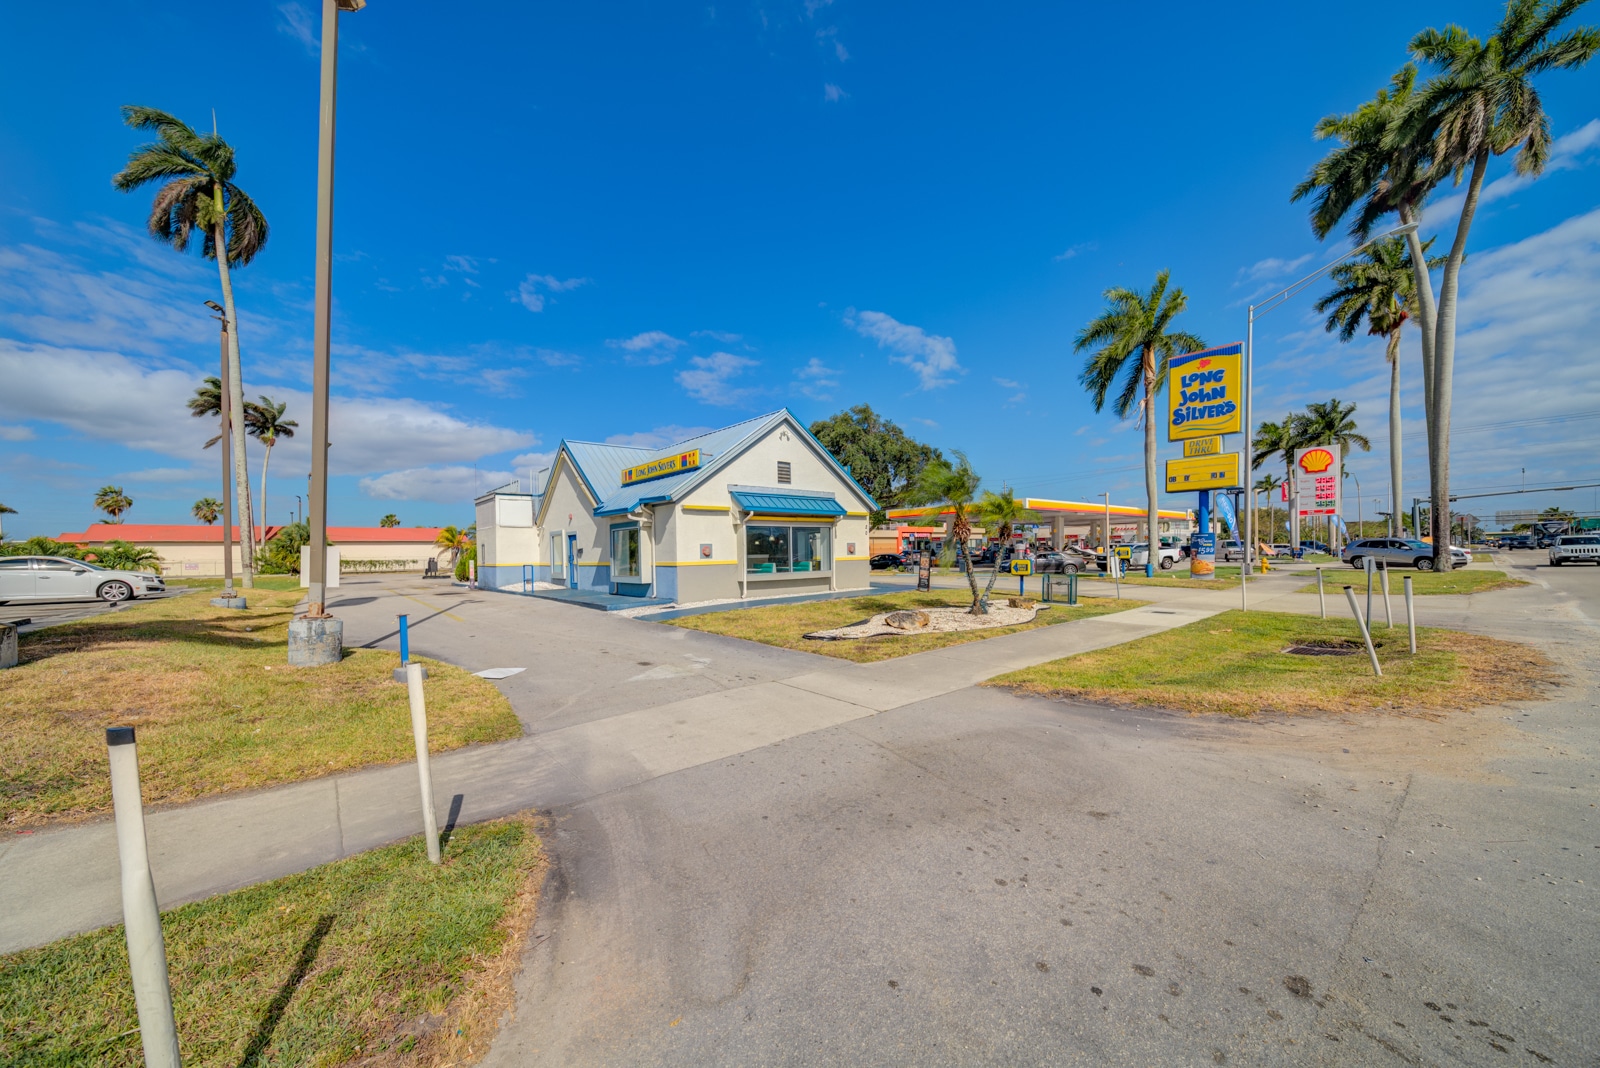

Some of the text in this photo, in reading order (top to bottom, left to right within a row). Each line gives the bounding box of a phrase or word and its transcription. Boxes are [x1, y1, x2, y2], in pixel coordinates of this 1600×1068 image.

[1181, 369, 1226, 389] LONG
[1189, 438, 1213, 448] DRIVE
[1190, 446, 1213, 455] THRU
